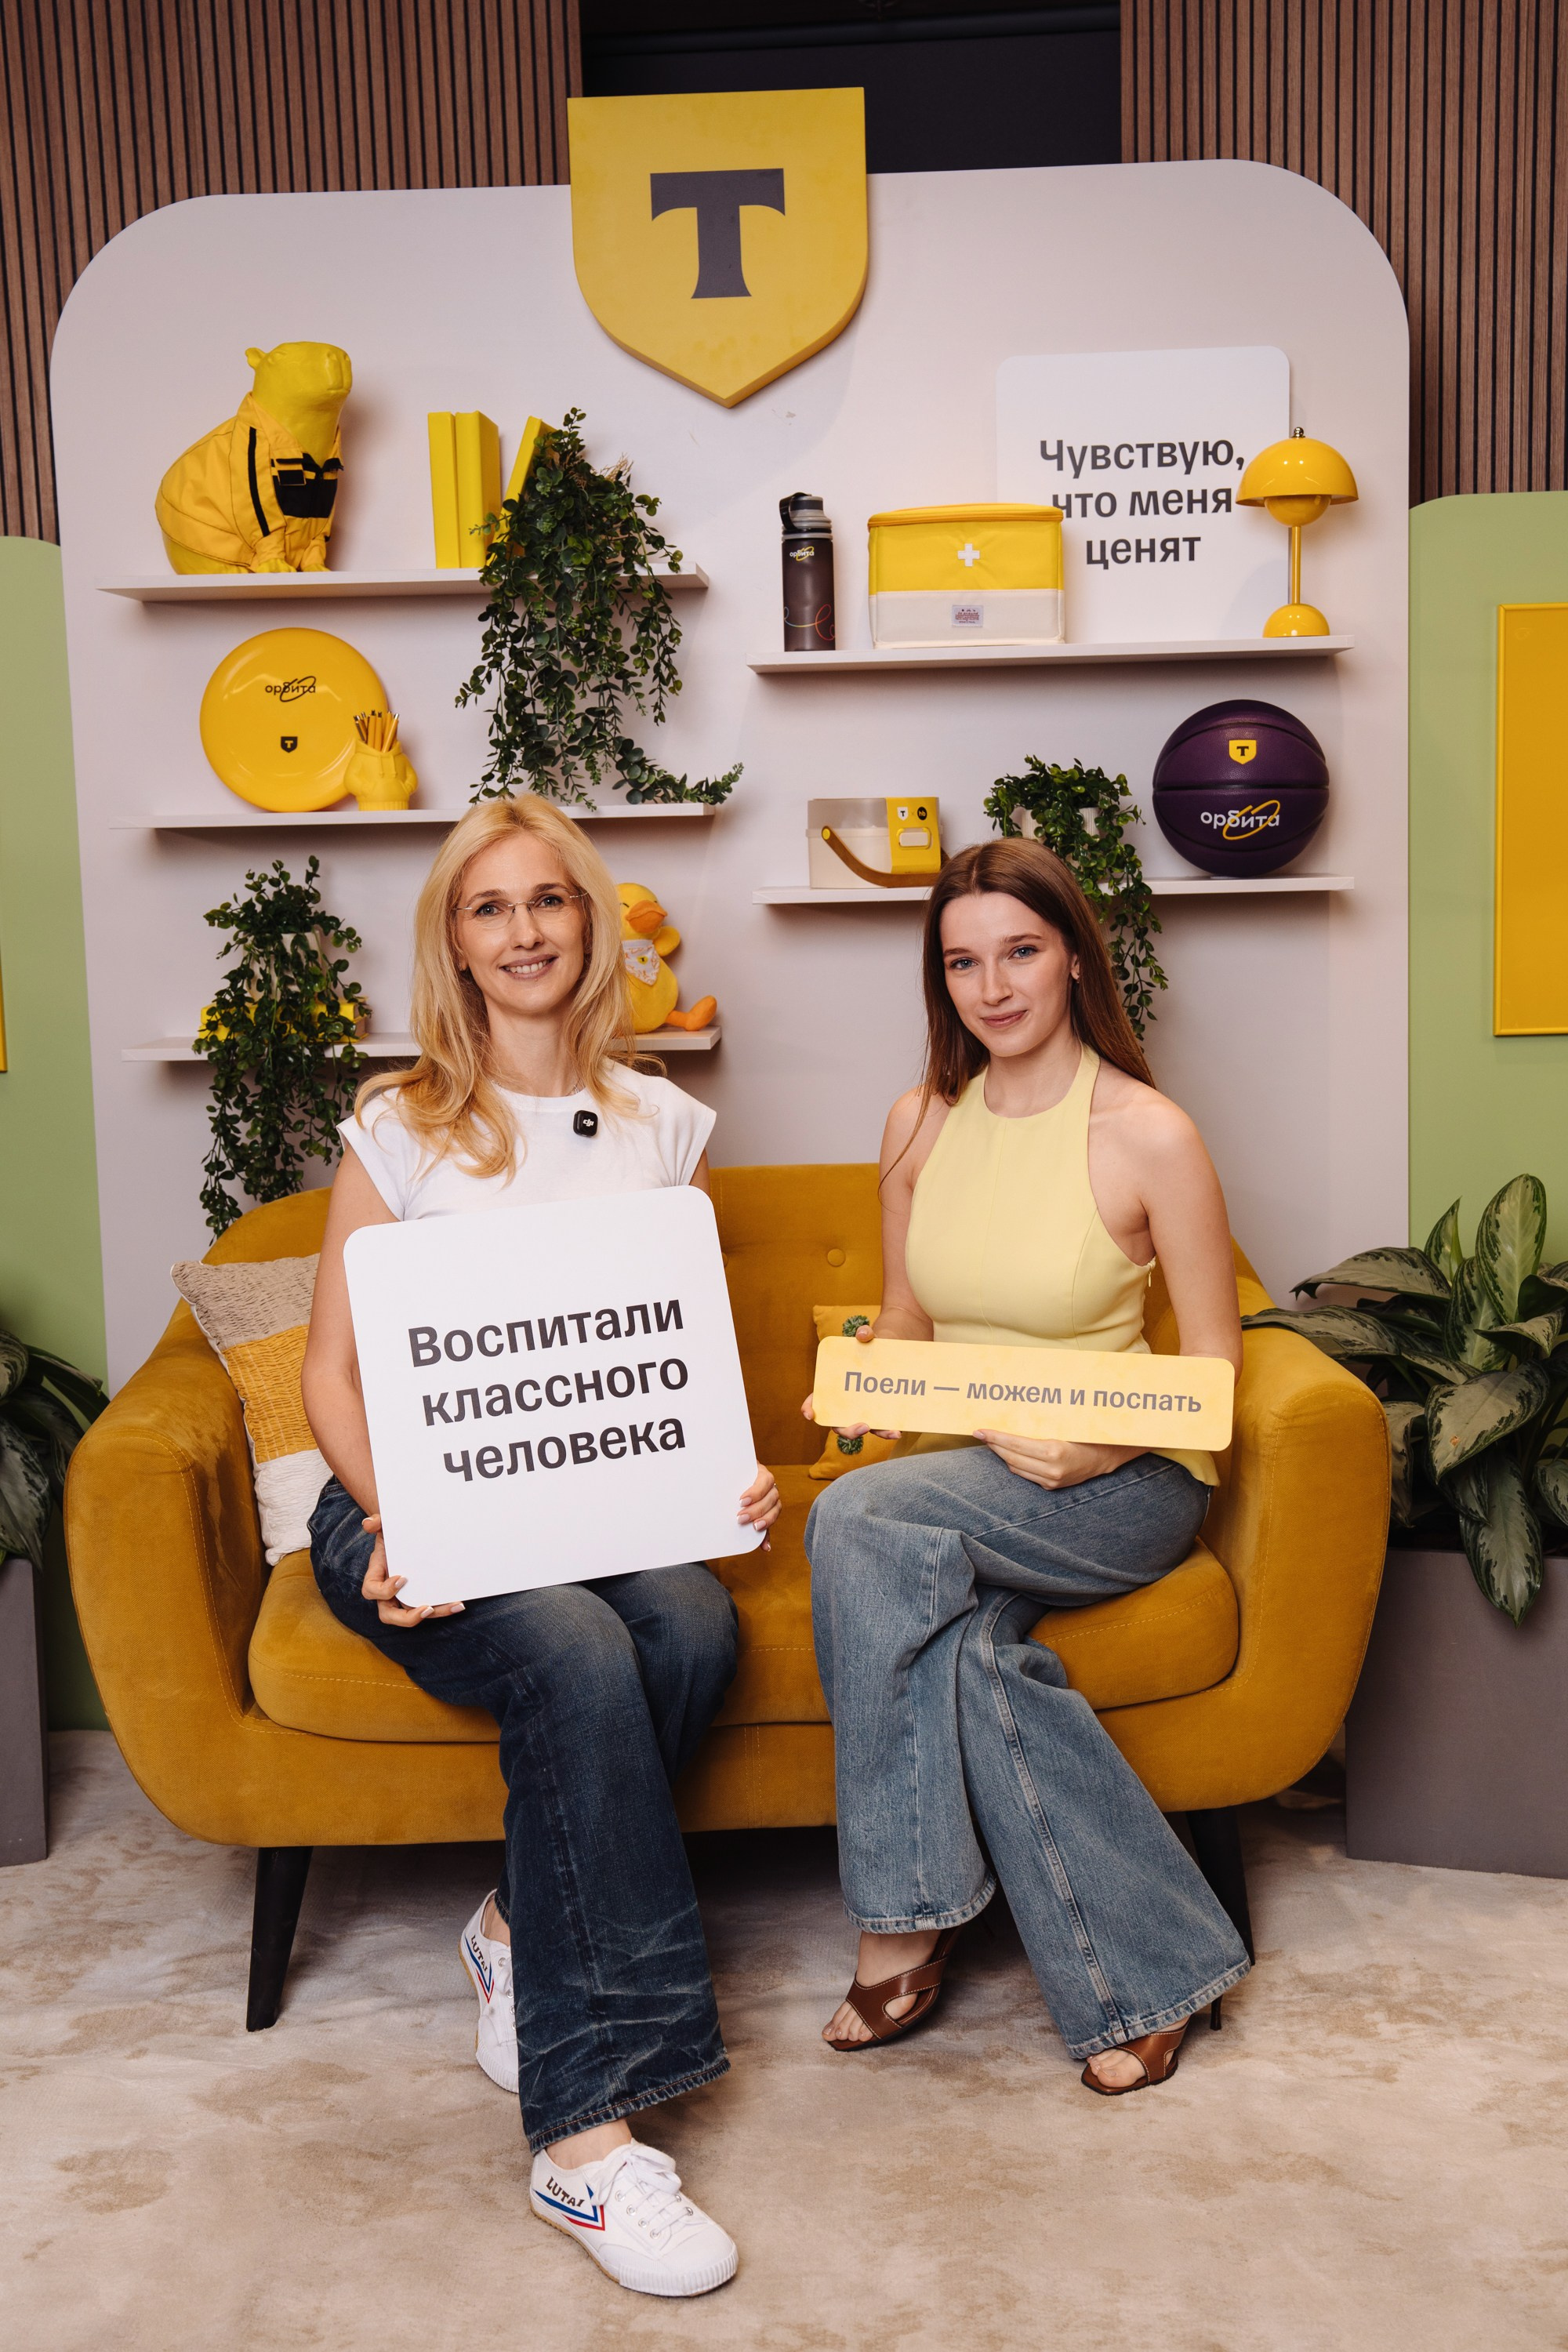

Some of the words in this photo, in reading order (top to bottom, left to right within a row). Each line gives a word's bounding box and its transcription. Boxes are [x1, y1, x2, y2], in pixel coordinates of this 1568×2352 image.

[1040, 439, 1245, 479] Чувствую,
[1052, 492, 1117, 518] что
[1129, 488, 1232, 517] меня
[1086, 536, 1202, 570] ценят
[1200, 809, 1280, 829] орбита
[408, 1299, 684, 1367] Воспитали
[422, 1358, 688, 1426] классного
[844, 1371, 926, 1396] Поели
[967, 1381, 1062, 1404] можем
[1069, 1387, 1086, 1406] и
[1093, 1389, 1203, 1414] поспать
[443, 1417, 686, 1482] человека
[471, 1934, 488, 1973] LUTAI
[546, 2176, 585, 2207] LUTAI
